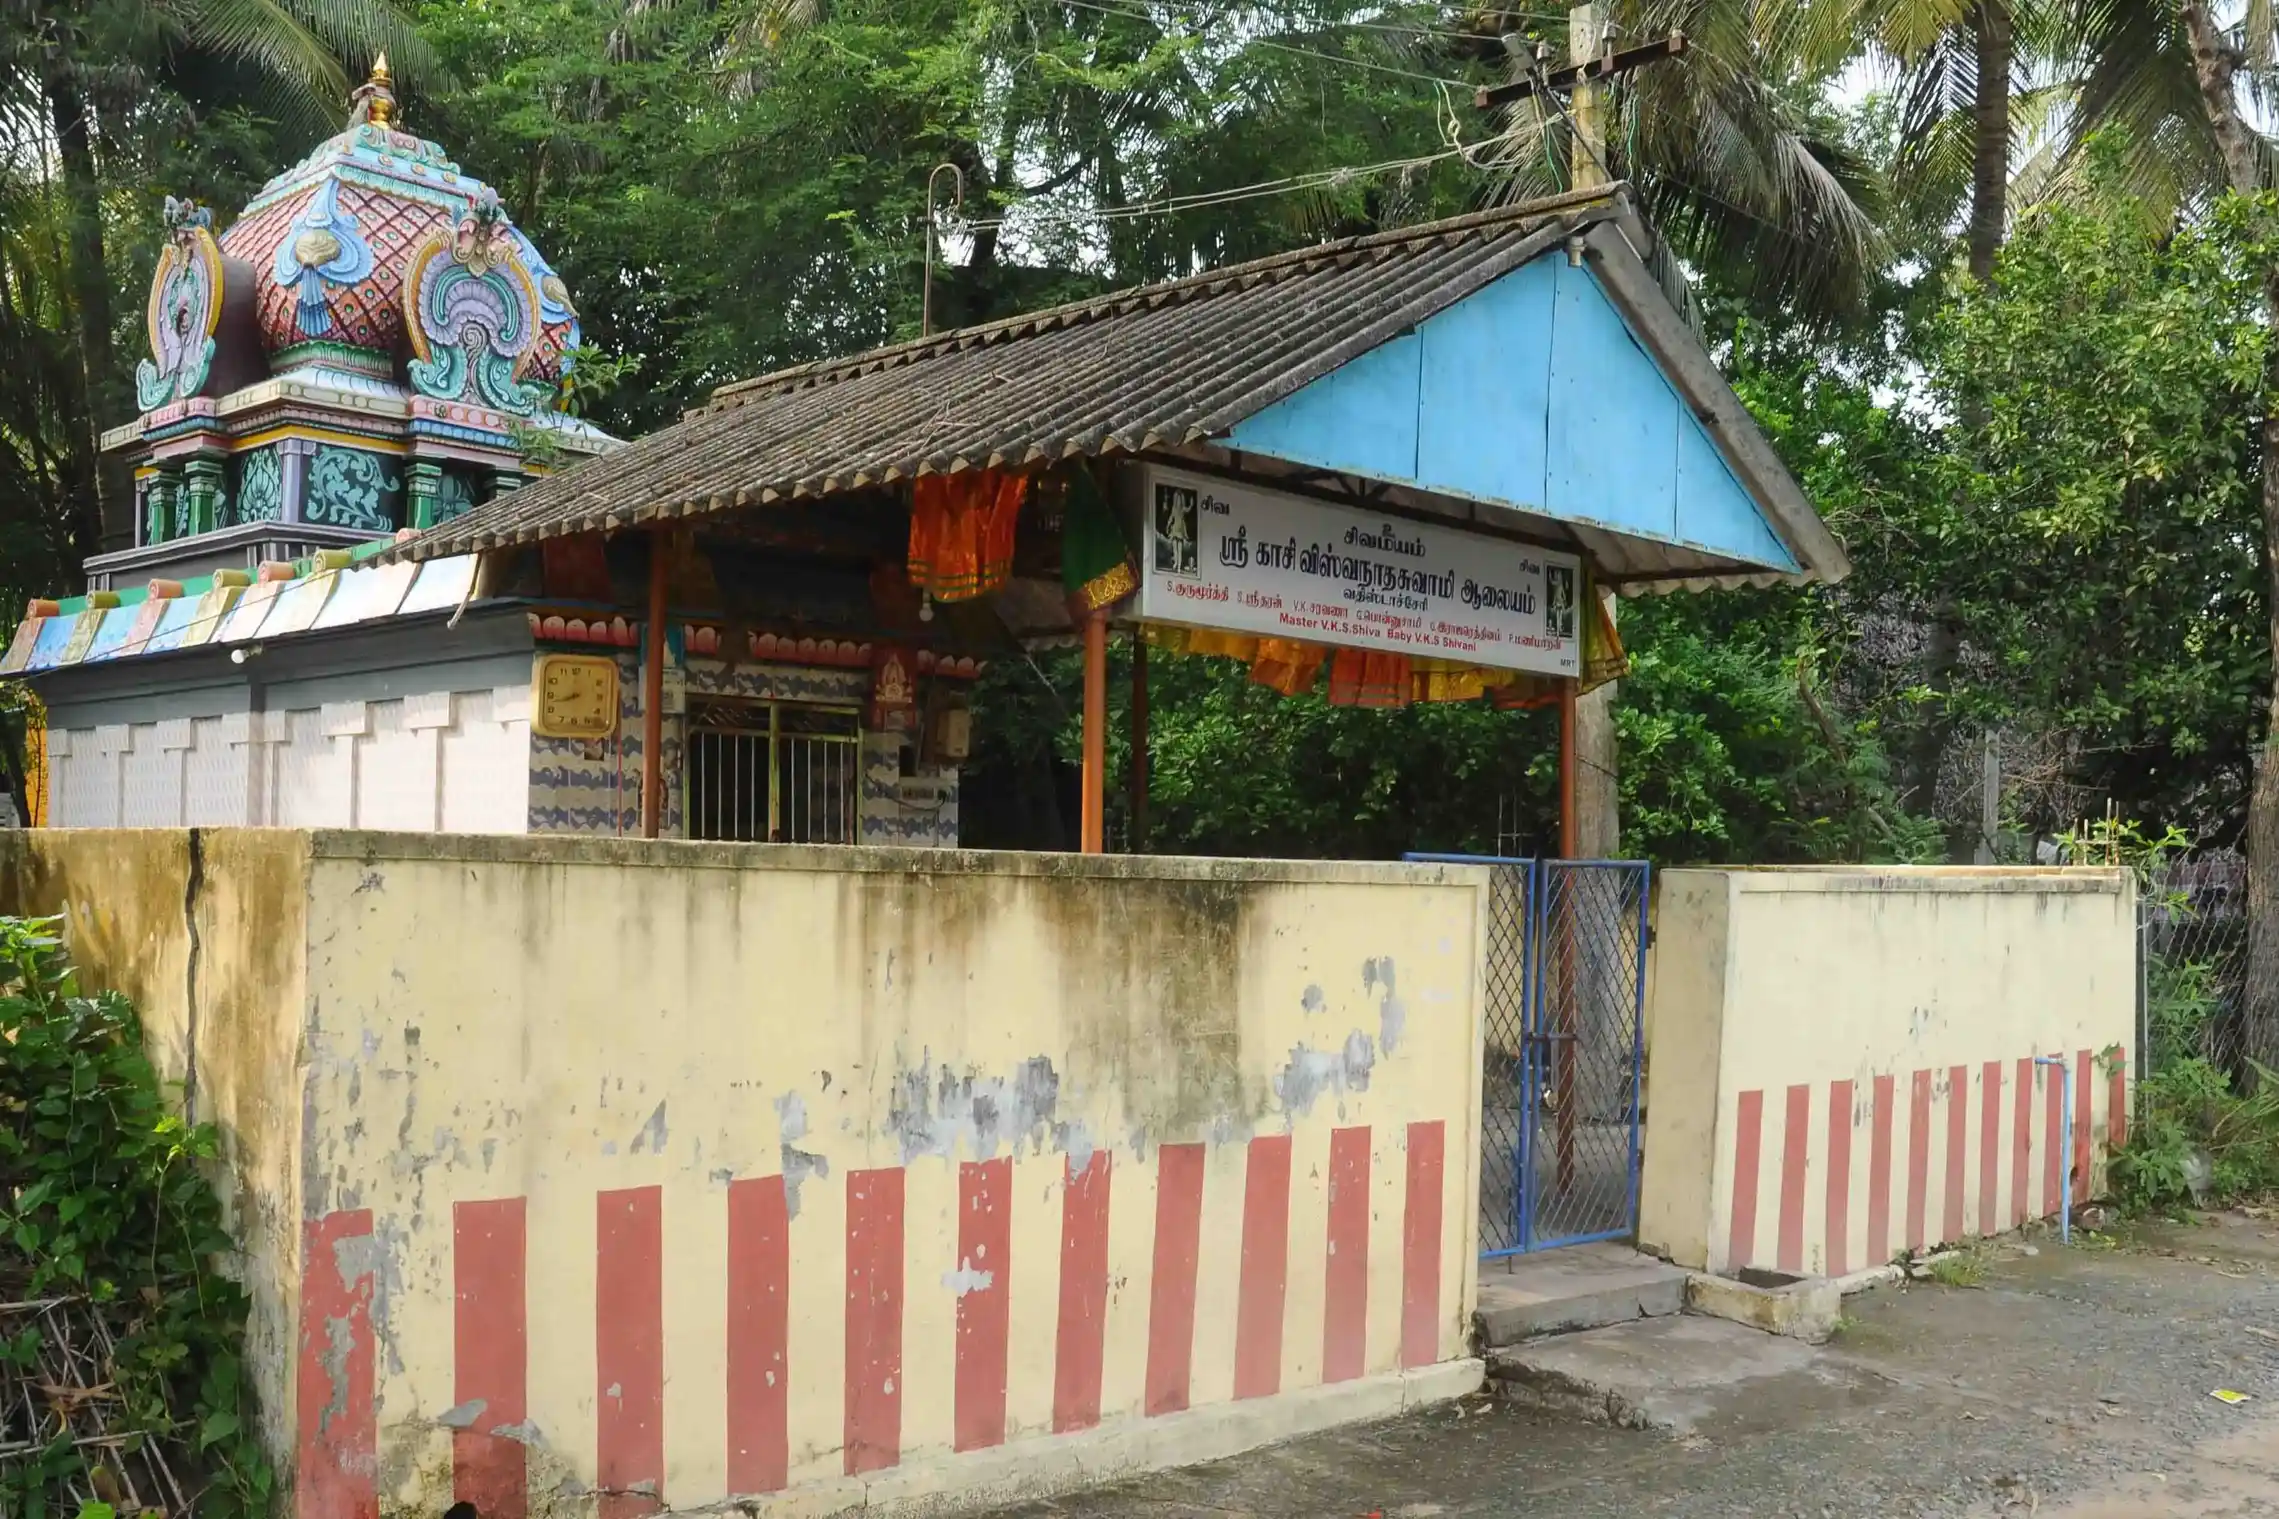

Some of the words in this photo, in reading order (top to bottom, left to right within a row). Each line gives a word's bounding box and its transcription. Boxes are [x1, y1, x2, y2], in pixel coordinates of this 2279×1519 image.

[1200, 495, 1230, 516] சிவ
[1343, 526, 1426, 557] சிவமயம்
[1461, 578, 1536, 615] ஆலையம்
[1280, 612, 1318, 629] Master
[1387, 628, 1412, 644] Baby
[1443, 636, 1477, 652] Shivani
